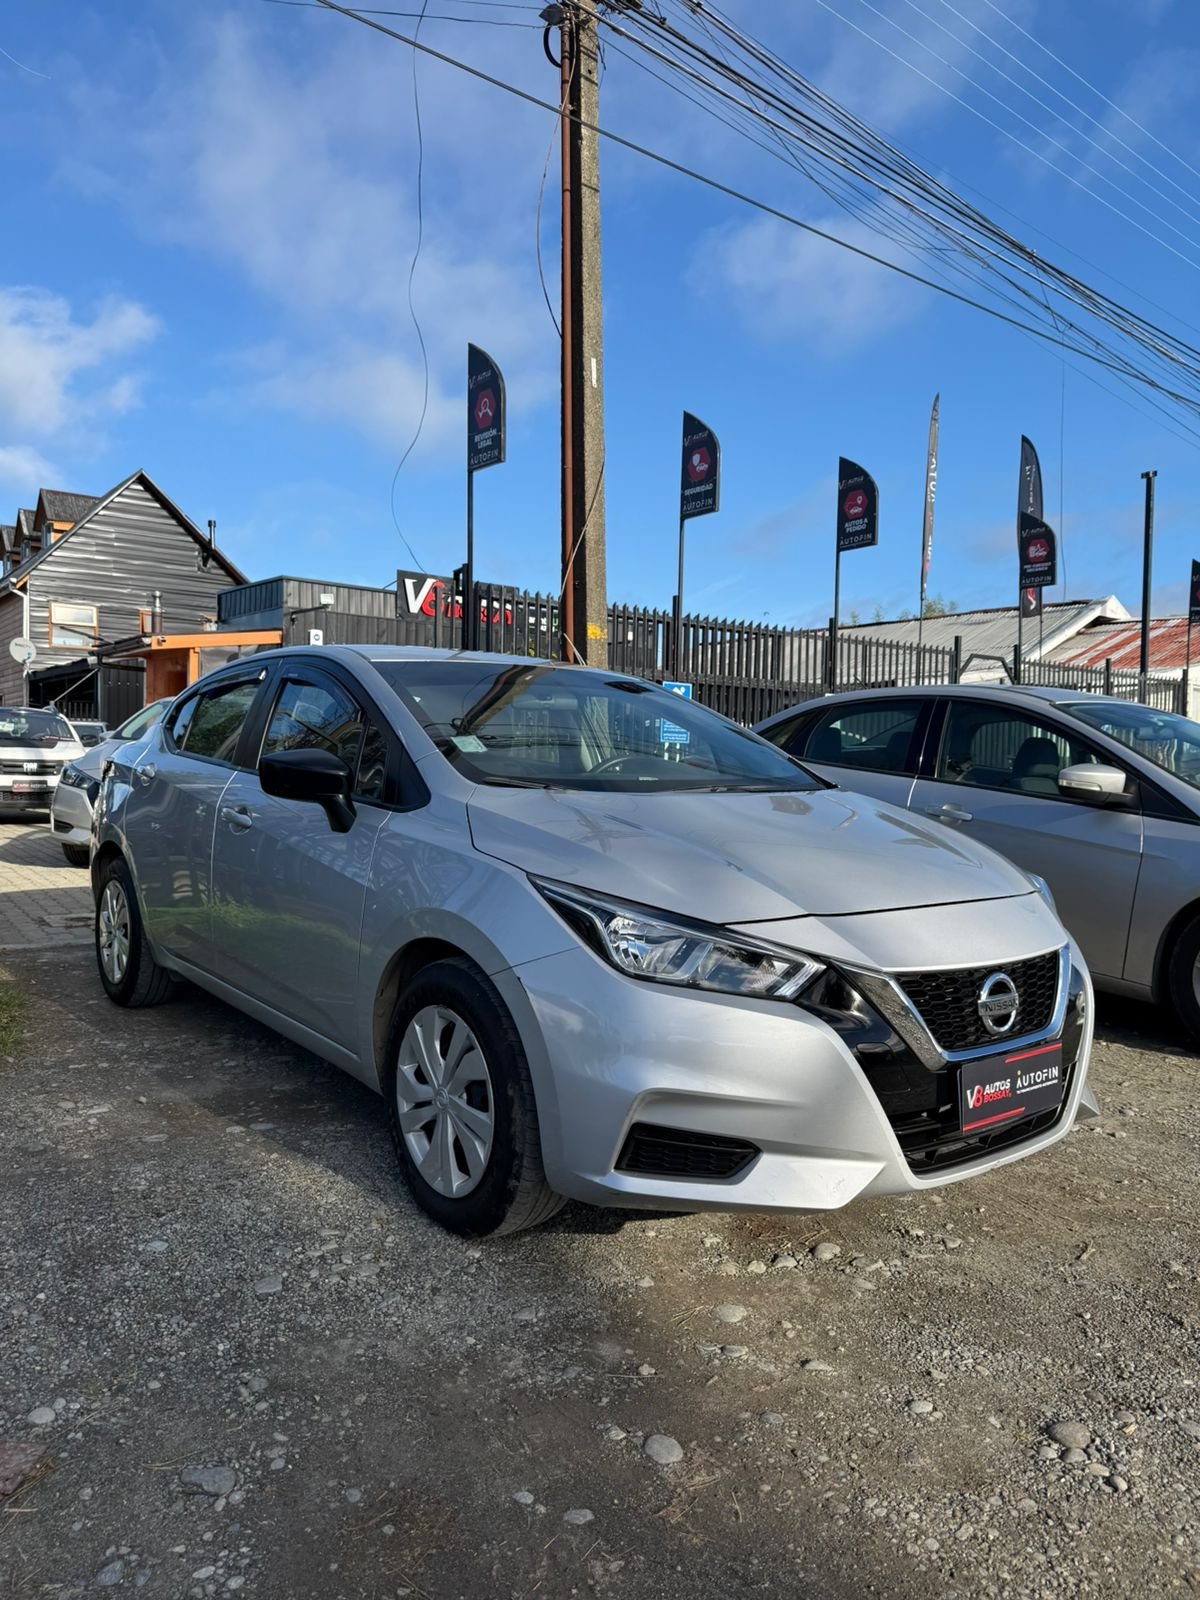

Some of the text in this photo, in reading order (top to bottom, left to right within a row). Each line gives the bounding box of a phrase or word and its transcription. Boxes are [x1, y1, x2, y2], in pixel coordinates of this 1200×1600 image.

[478, 438, 492, 449] LEGAL
[471, 449, 499, 465] AUTOFIN
[684, 483, 713, 496] SEGURIDAD
[683, 498, 713, 511] AUTOFIN
[844, 518, 863, 528] AUTOS
[846, 524, 866, 533] PEDIDO
[840, 533, 872, 546] AUTOFIN
[1016, 1066, 1059, 1089] AUTOFIN
[966, 1085, 983, 1109] V8
[984, 1079, 1011, 1095] AUTOS
[984, 1089, 1011, 1104] BOSSAY
